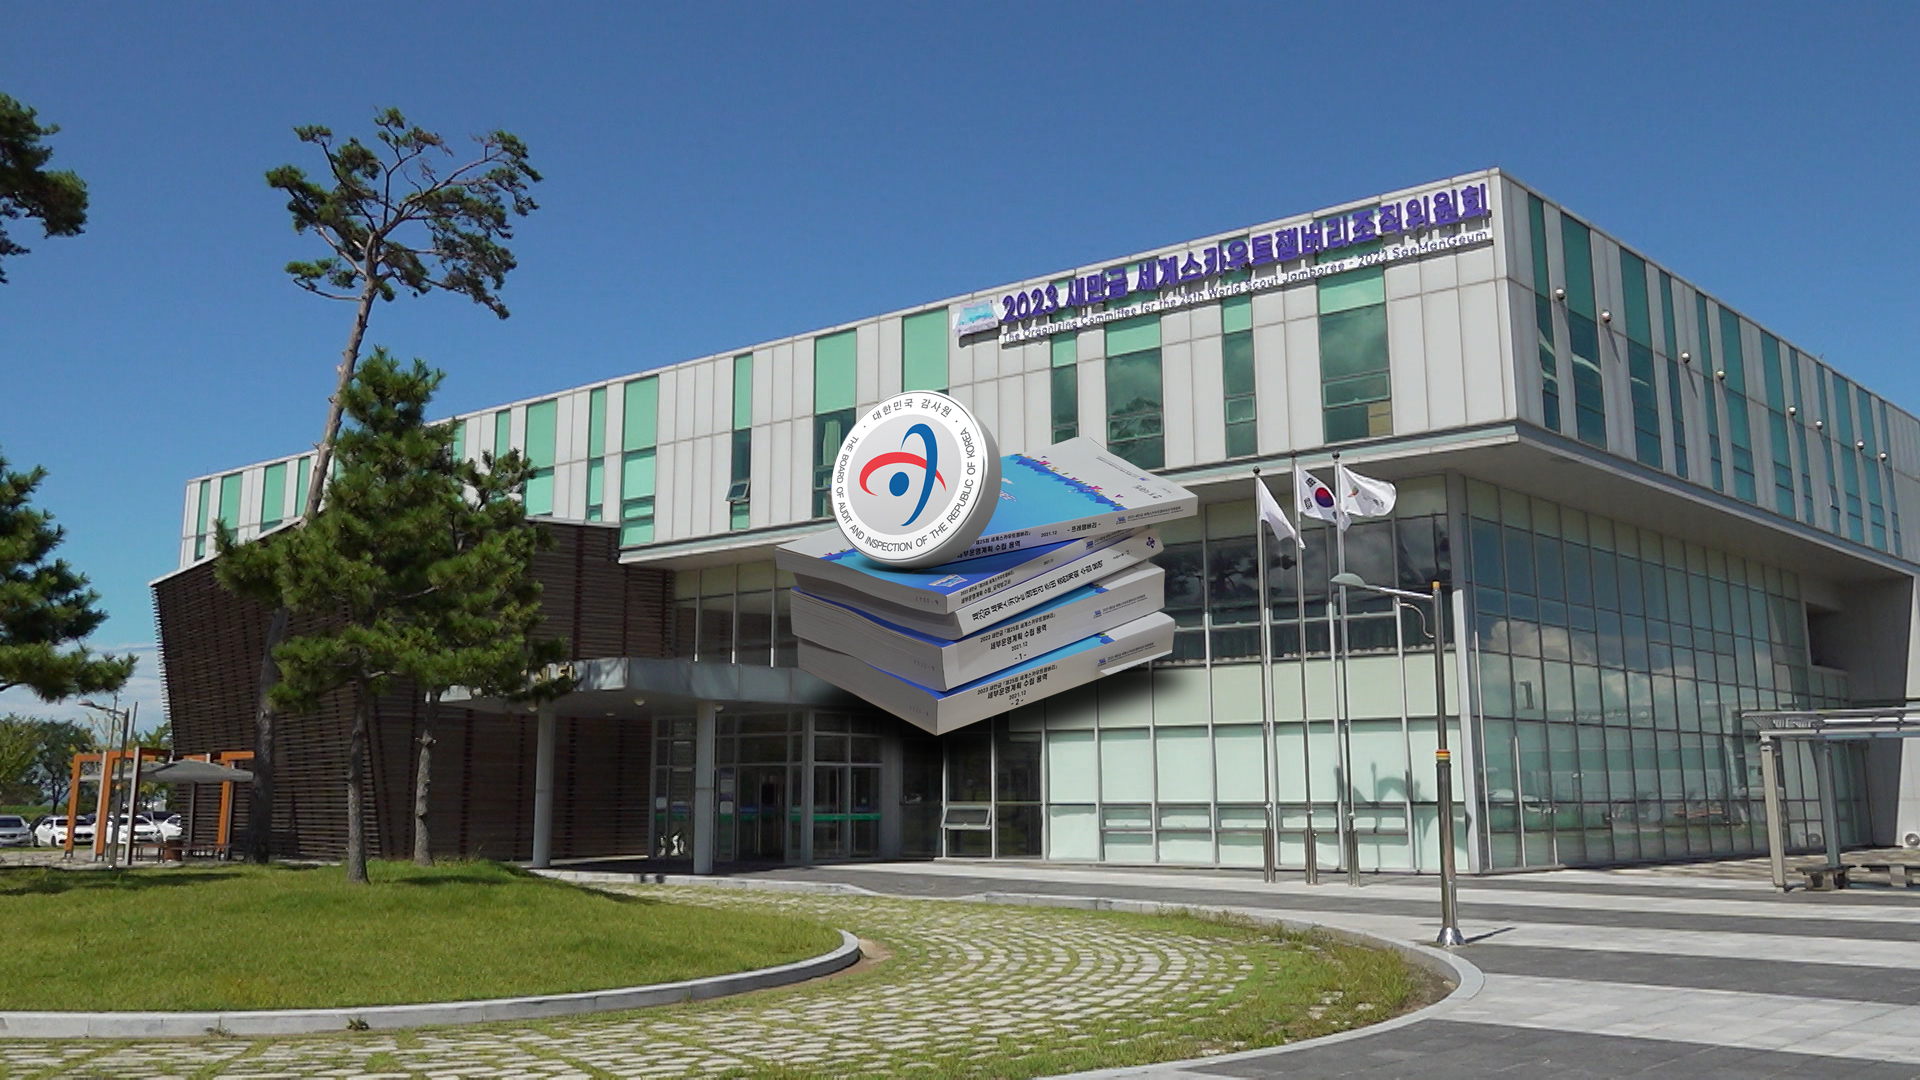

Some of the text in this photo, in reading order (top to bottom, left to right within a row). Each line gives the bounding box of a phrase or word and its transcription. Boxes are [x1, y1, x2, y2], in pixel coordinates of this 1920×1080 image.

[1000, 183, 1488, 323] 2023 새만금 세계스카우트잼버리조직위원회
[1082, 307, 1137, 326] Committee
[1041, 530, 1057, 538] 2021.12
[994, 543, 1006, 551] 수립
[980, 635, 991, 643] 2023
[992, 630, 1003, 639] 새만금
[990, 624, 1047, 650] 세부운영계획 수립 용역
[1011, 641, 1028, 651] 2021.12
[977, 687, 989, 695] 2023
[989, 682, 1002, 691] 새만금
[987, 673, 1048, 699] 세부운영계획 수립 용역
[1008, 690, 1026, 700] 2021.12
